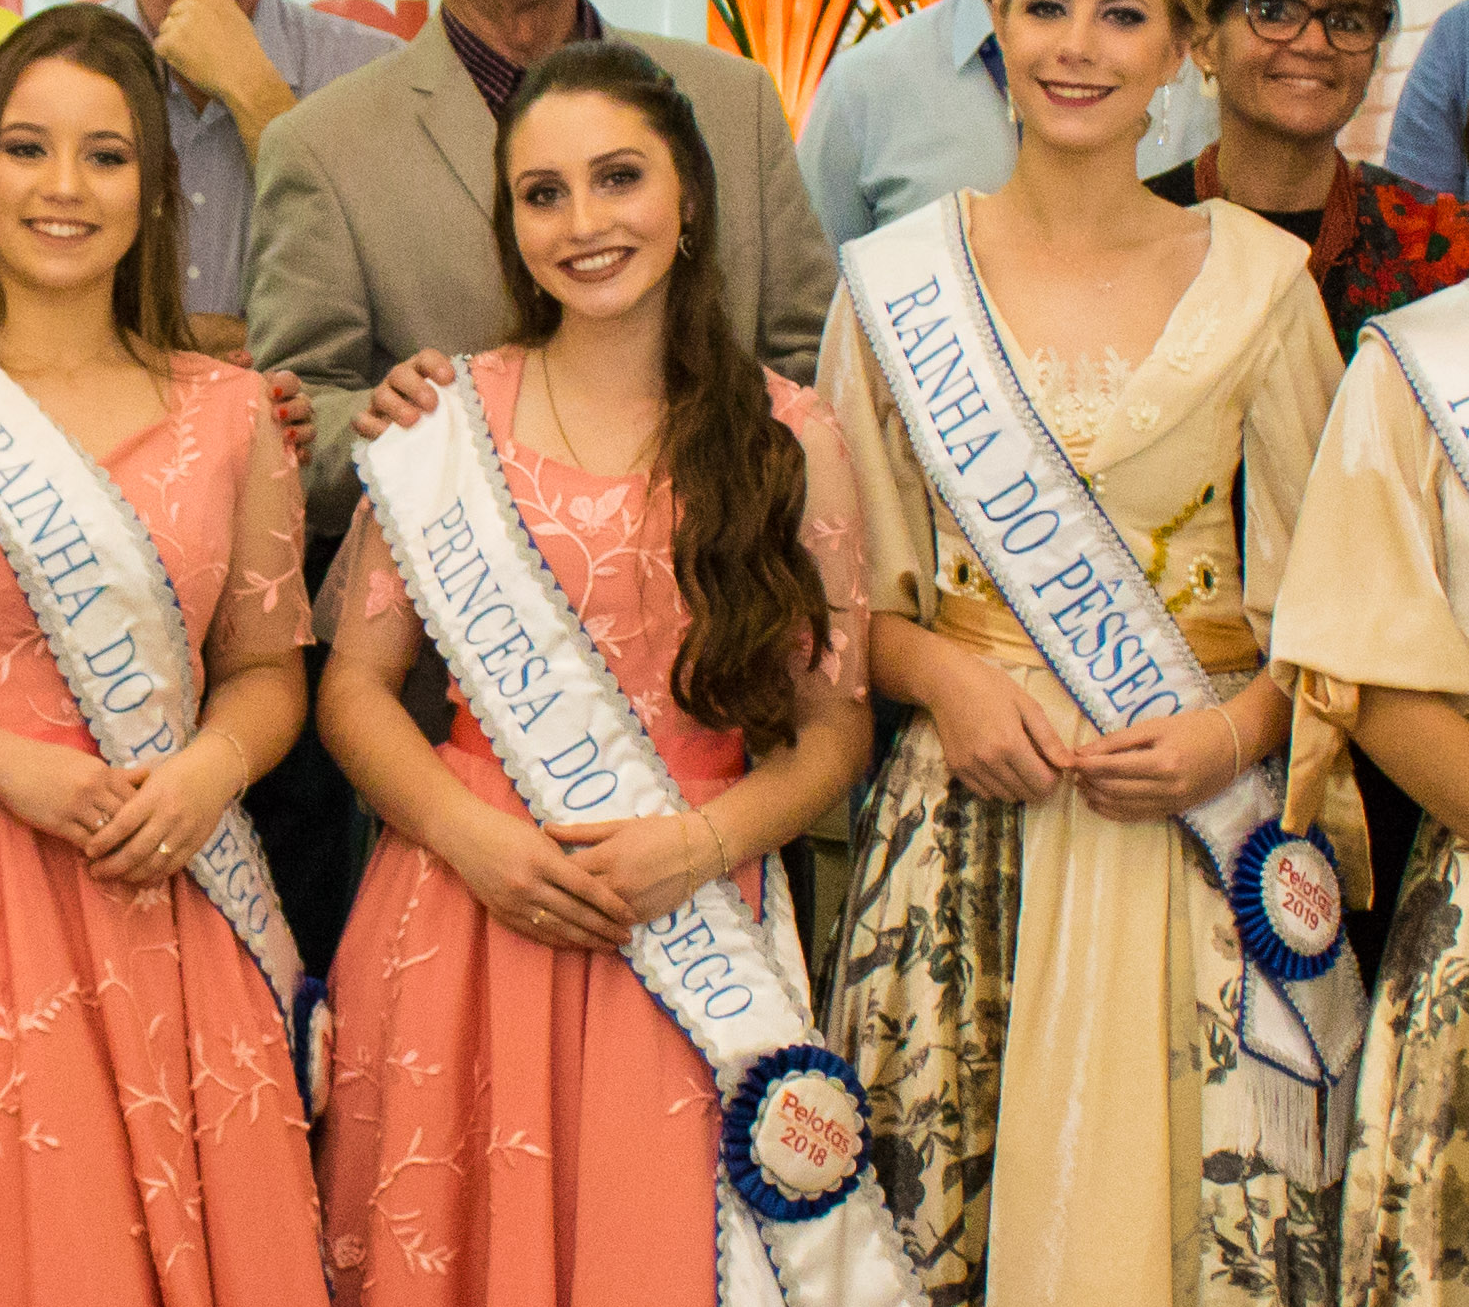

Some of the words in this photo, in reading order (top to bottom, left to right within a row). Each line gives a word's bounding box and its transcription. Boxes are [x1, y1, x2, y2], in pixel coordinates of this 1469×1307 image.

[885, 272, 1003, 478] RAINHA
[978, 470, 1062, 557] DO
[1030, 552, 1184, 730] PÊSSEG
[83, 629, 155, 717] DO
[419, 502, 551, 738] PRINCESA
[538, 747, 620, 815] DO
[1282, 892, 1319, 931] 2019
[780, 1126, 828, 1168] 2018
[782, 1090, 850, 1155] Pelotas
